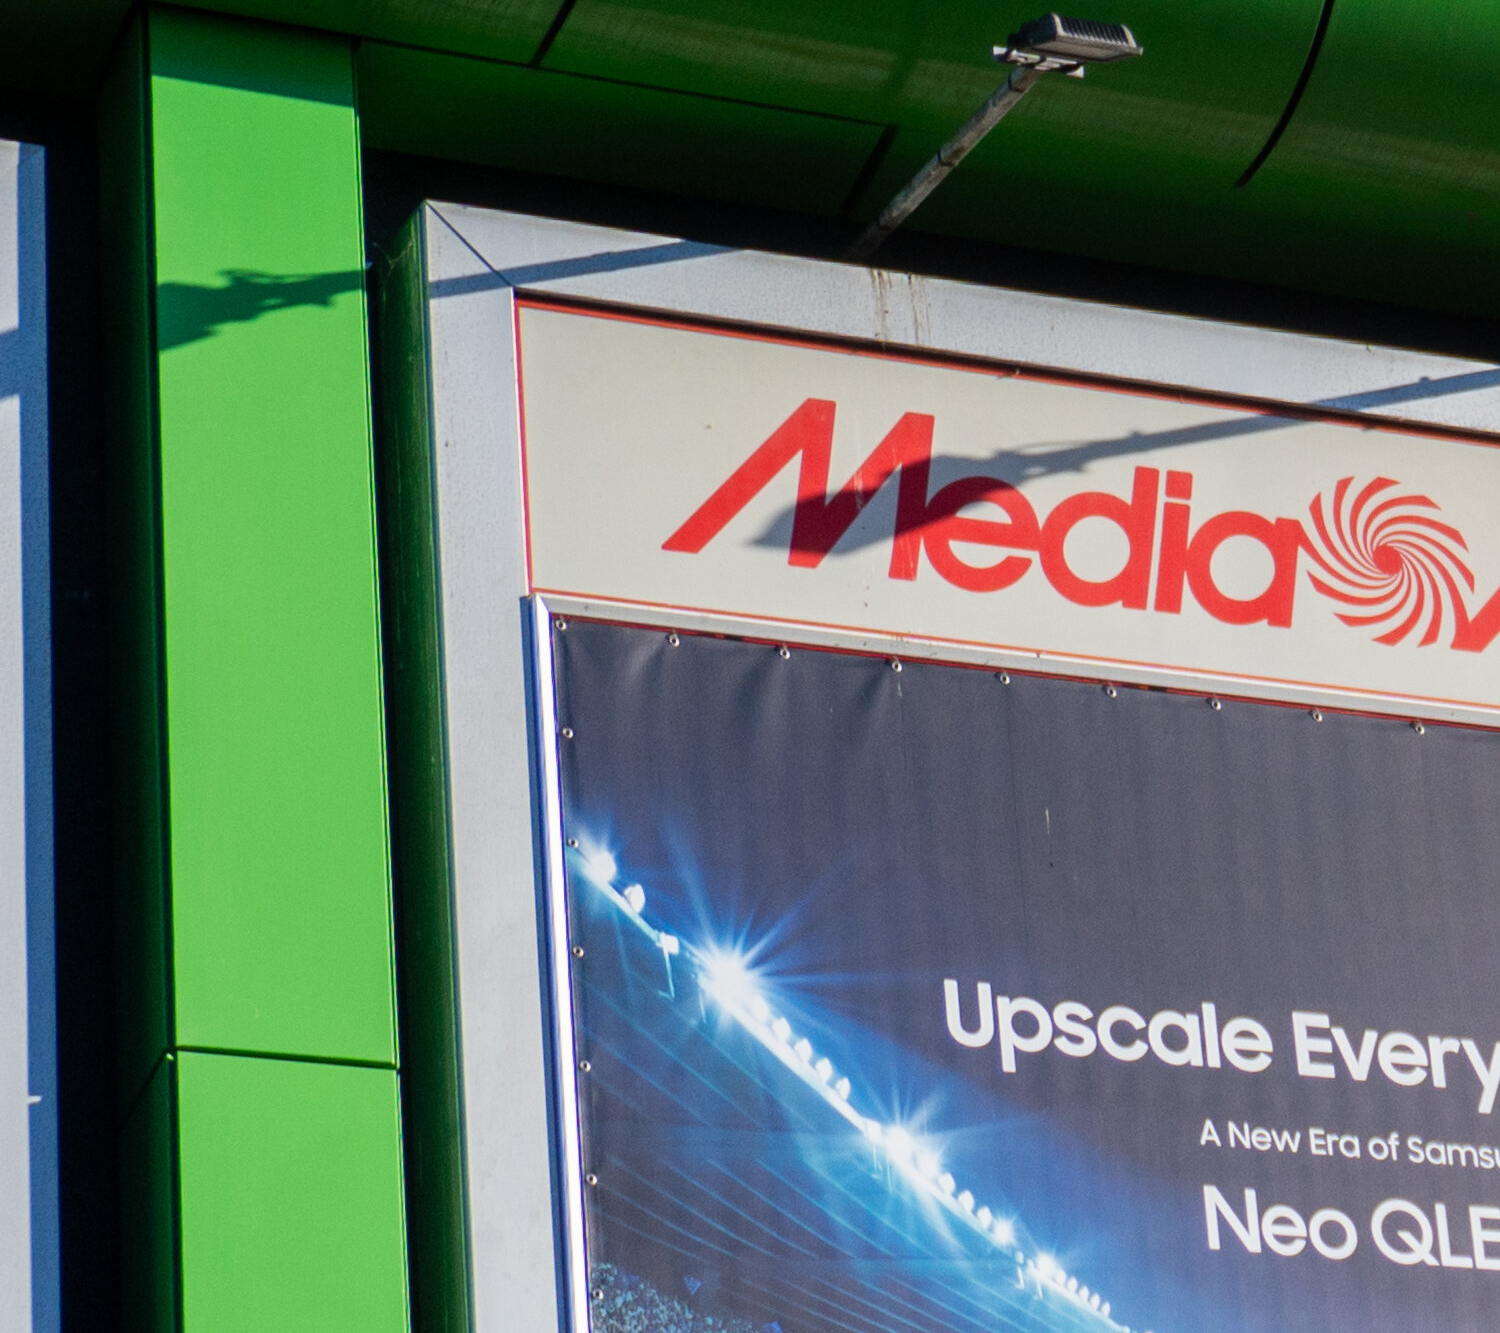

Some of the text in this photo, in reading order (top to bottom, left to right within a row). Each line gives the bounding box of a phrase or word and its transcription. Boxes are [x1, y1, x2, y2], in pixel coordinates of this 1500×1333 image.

[942, 977, 1275, 1074] Upscale
[1199, 1118, 1222, 1148] A
[1227, 1120, 1302, 1153] New
[1307, 1127, 1361, 1159] Era
[1367, 1131, 1400, 1162] of
[1202, 1183, 1358, 1261] Neo
